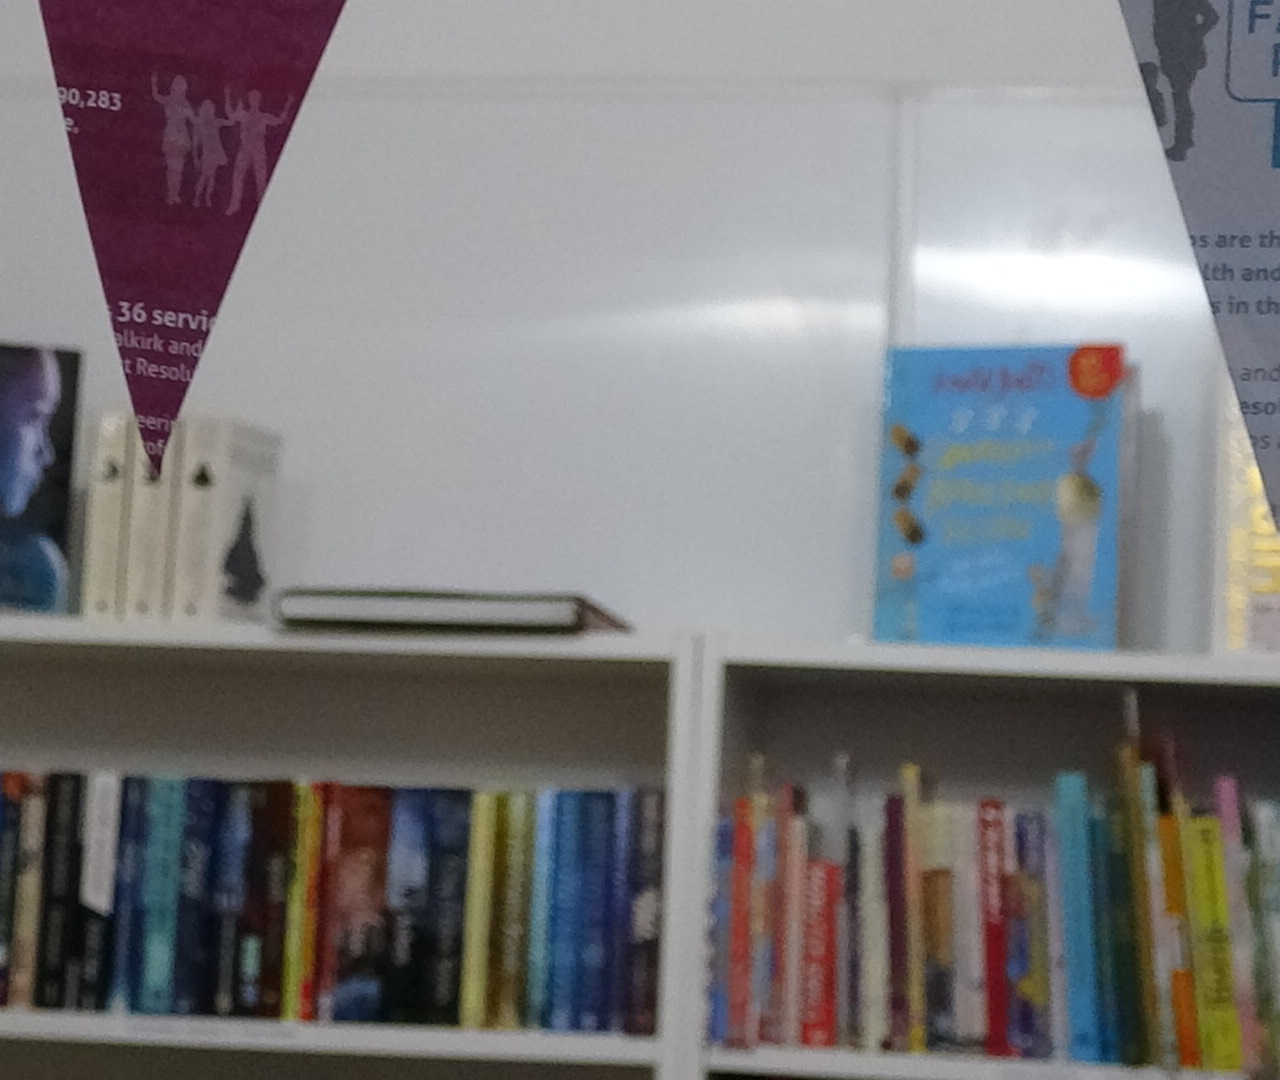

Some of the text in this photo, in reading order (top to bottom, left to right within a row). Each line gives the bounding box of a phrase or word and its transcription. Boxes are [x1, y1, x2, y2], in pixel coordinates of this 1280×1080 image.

[1214, 233, 1252, 250] are
[117, 300, 148, 323] 36
[1227, 297, 1250, 315] in
